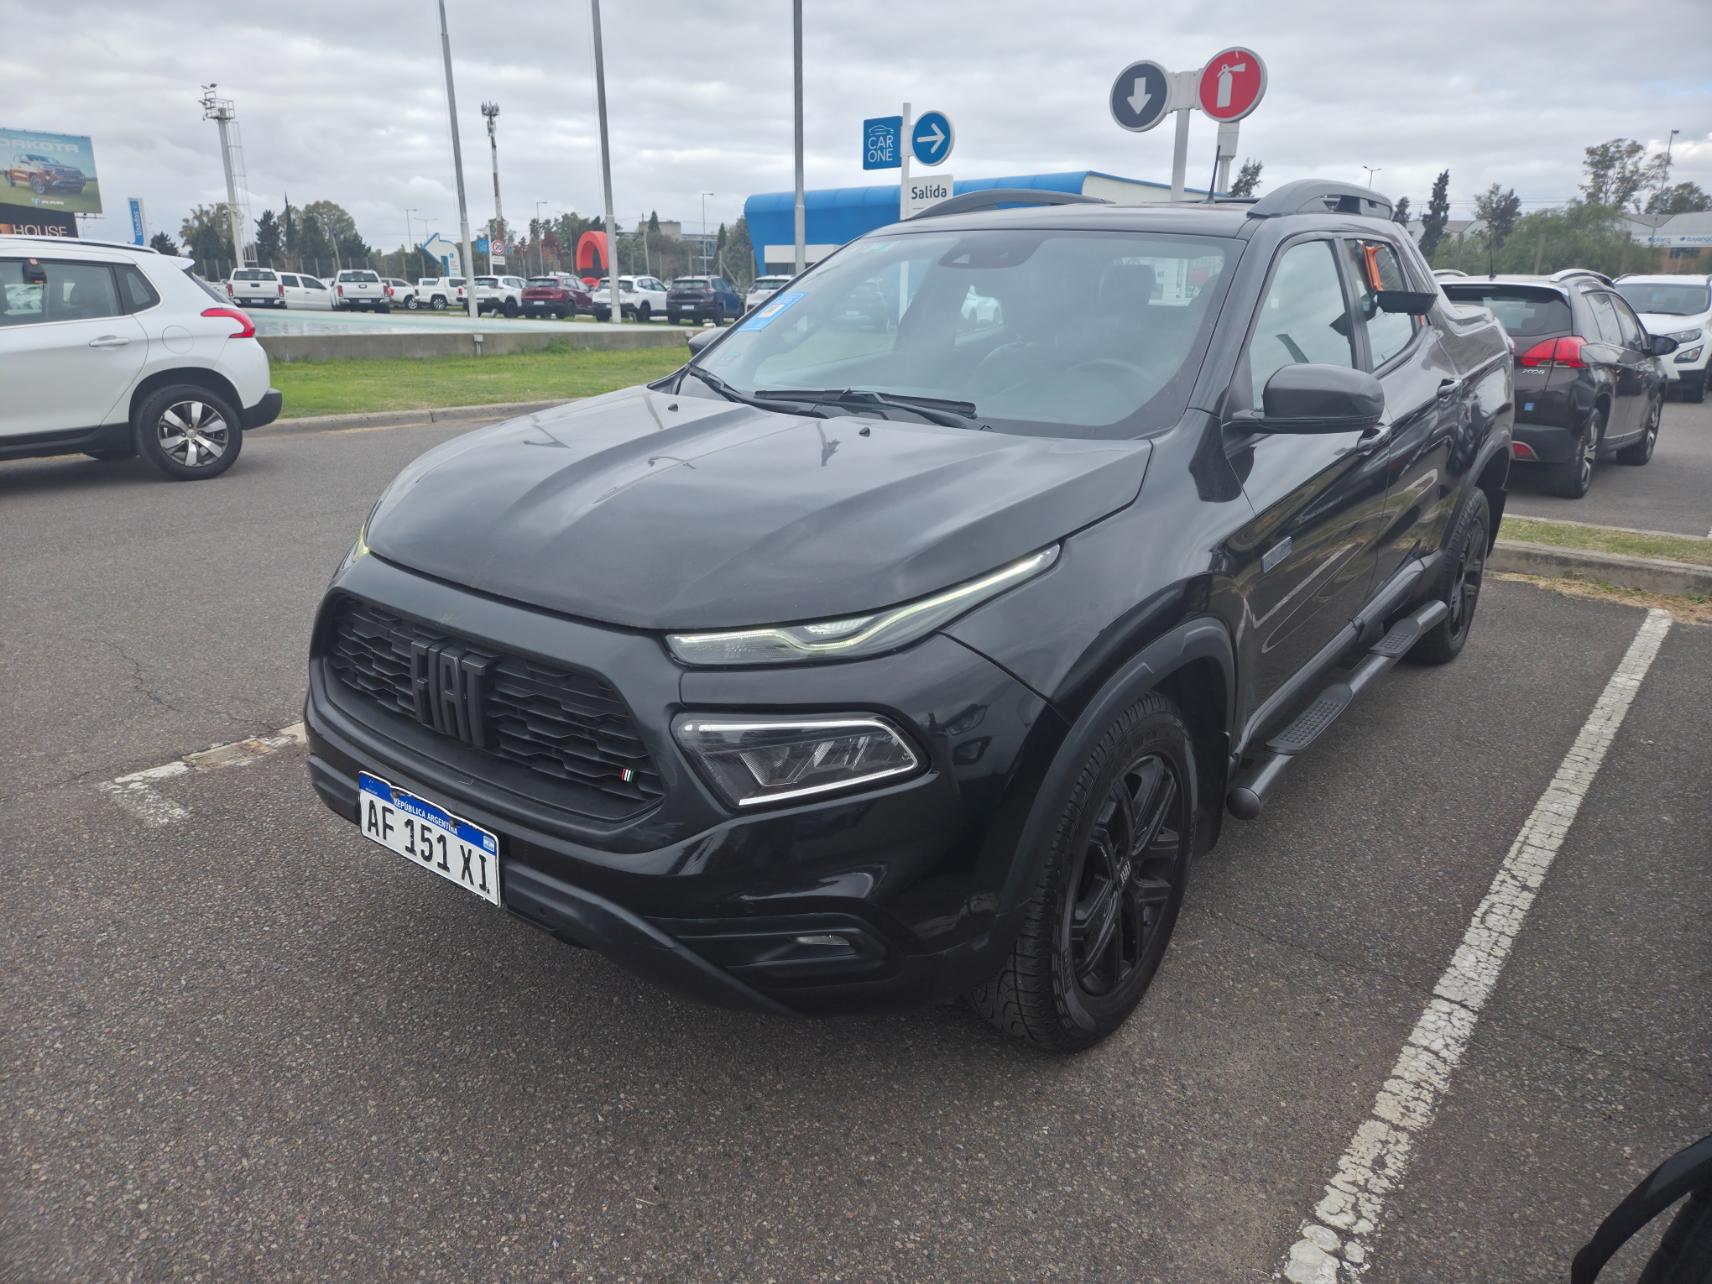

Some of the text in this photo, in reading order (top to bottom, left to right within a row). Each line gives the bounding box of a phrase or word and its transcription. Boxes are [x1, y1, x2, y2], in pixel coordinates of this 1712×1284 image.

[868, 135, 894, 150] CAR
[868, 148, 893, 163] ONE
[911, 184, 947, 200] Salida
[12, 223, 67, 238] HOUSE
[410, 640, 489, 749] FIAT
[393, 799, 426, 818] REPÚBLICA
[367, 799, 487, 892] AF 151 XI
